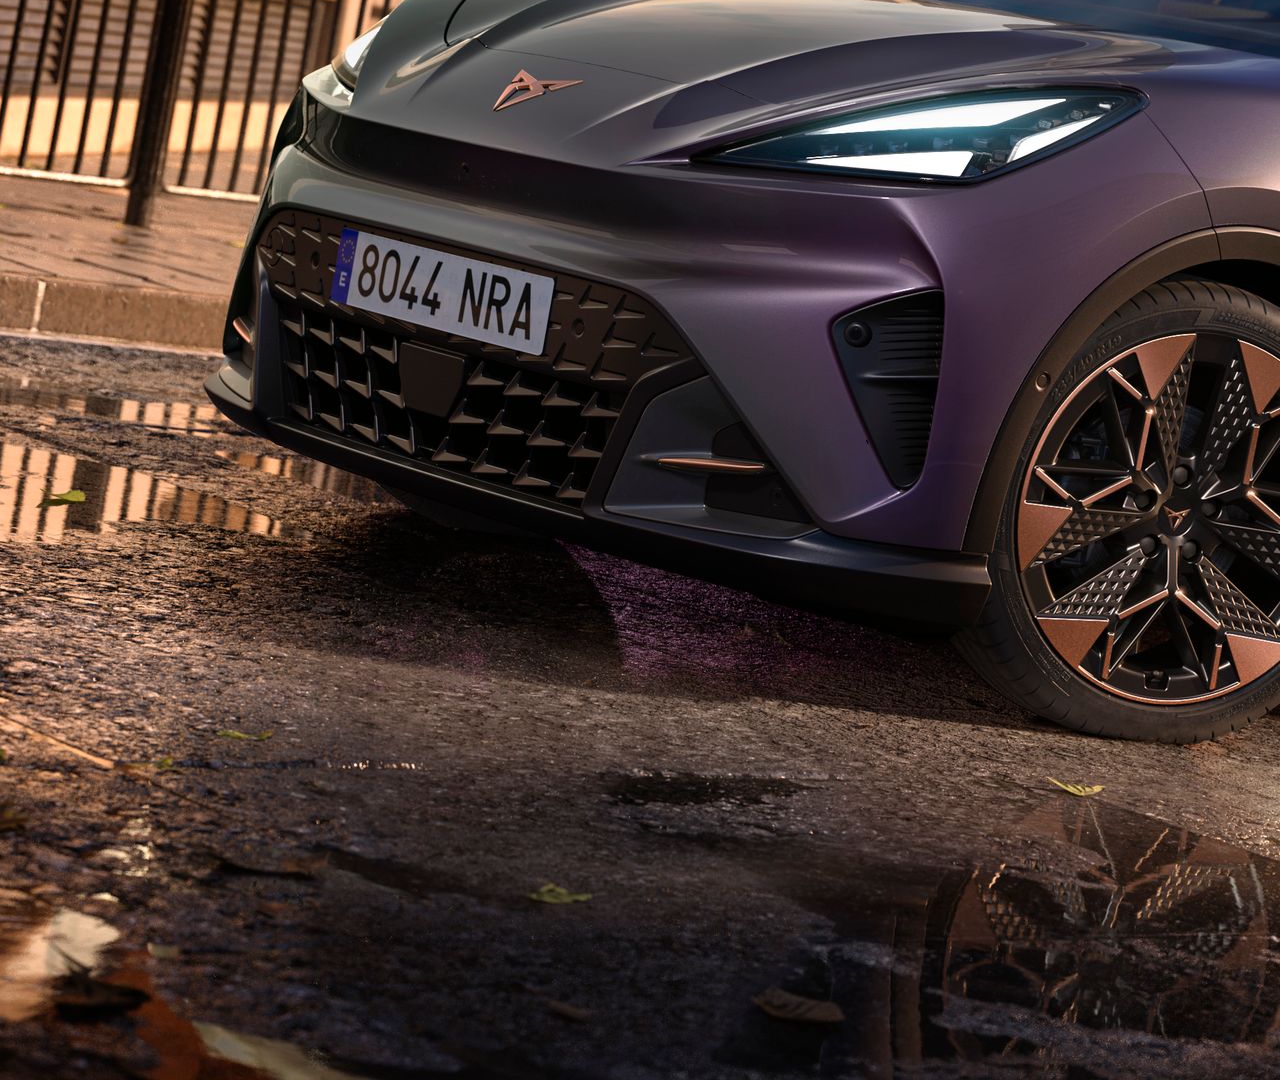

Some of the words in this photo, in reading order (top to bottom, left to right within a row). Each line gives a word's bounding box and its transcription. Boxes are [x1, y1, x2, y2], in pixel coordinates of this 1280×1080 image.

[339, 271, 347, 287] E
[358, 244, 443, 316] 8044
[457, 268, 531, 340] NRA
